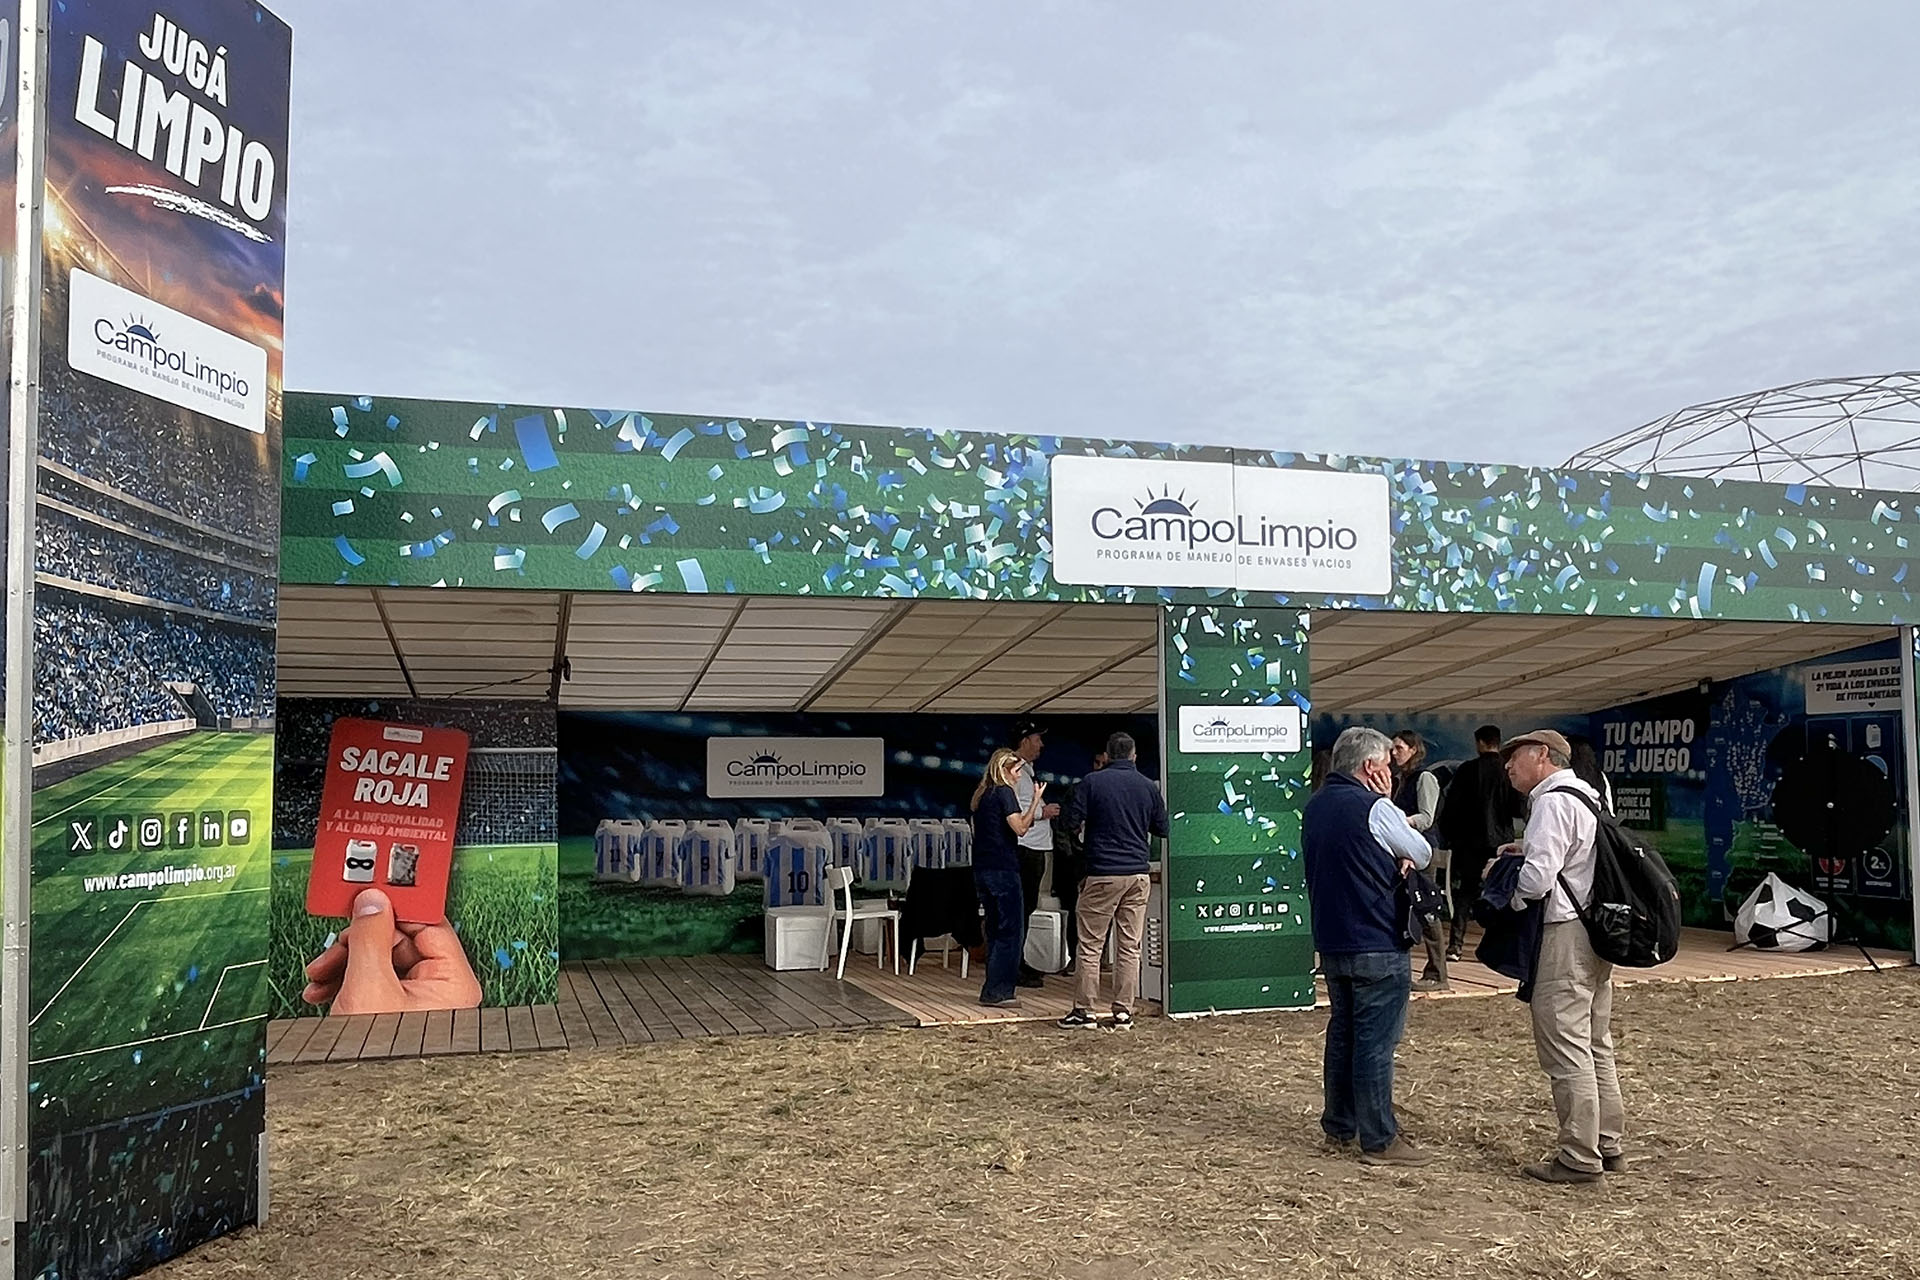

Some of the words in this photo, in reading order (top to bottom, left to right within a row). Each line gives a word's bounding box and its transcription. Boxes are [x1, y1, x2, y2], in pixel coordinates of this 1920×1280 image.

[139, 12, 228, 107] JUGÁ
[75, 35, 275, 221] LIMPIO
[94, 318, 249, 397] CampoLimpio
[96, 348, 138, 370] PROGRAMA
[140, 365, 149, 375] DE
[1091, 507, 1357, 556] CampoLimpio
[1096, 548, 1162, 560] PROGRAMA
[1167, 551, 1181, 561] DE
[1187, 552, 1233, 563] MANEJO
[1238, 555, 1252, 565] DE
[1257, 556, 1307, 568] ENVASES
[1312, 558, 1352, 569] VACIOS
[1811, 672, 1821, 681] LA
[1880, 666, 1889, 676] ES
[1843, 681, 1849, 690] A
[1193, 724, 1288, 738] CampoLimpio
[1603, 722, 1626, 746] TU
[1629, 718, 1695, 745] CAMPO
[340, 747, 454, 781] SACALE
[727, 760, 866, 780] CampoLimpio
[1603, 749, 1626, 773] DE
[1629, 747, 1690, 773] JUEGO
[353, 777, 429, 808] ROJA
[1640, 797, 1650, 808] LA
[334, 809, 341, 819] A
[345, 809, 360, 820] LA
[362, 811, 444, 828] INFORMALIDAD
[326, 821, 334, 831] Y
[336, 821, 350, 833] AL
[353, 823, 384, 836] DAÑO
[385, 826, 448, 841] AMBIENTAL
[610, 849, 621, 863] 11
[84, 864, 237, 893] www.campolimpio.org.ar
[788, 871, 809, 893] 10
